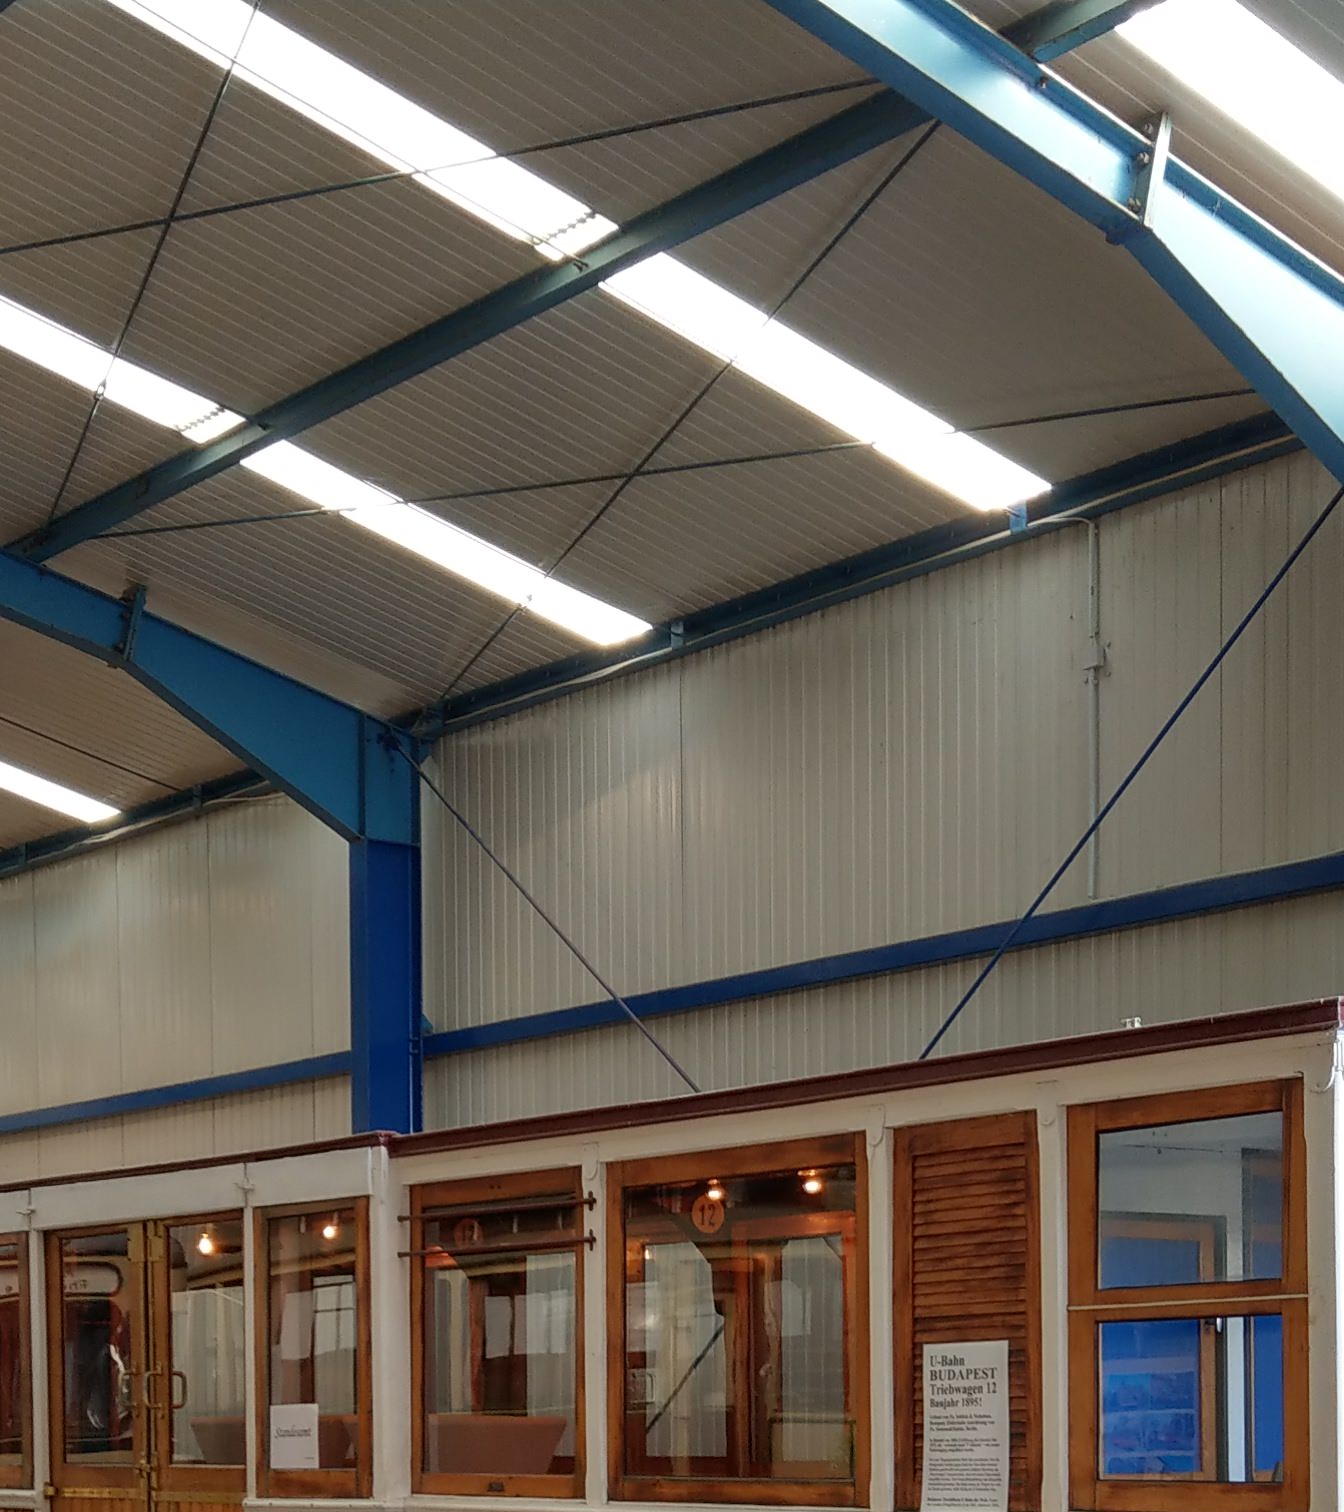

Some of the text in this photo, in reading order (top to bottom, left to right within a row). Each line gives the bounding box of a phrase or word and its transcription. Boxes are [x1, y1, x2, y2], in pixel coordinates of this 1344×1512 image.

[699, 1203, 716, 1227] 12
[930, 1355, 965, 1367] U-Bahn
[930, 1367, 997, 1381] BUDAPEST
[930, 1381, 997, 1397] Triebwagen 12
[930, 1397, 959, 1410] Baujahr
